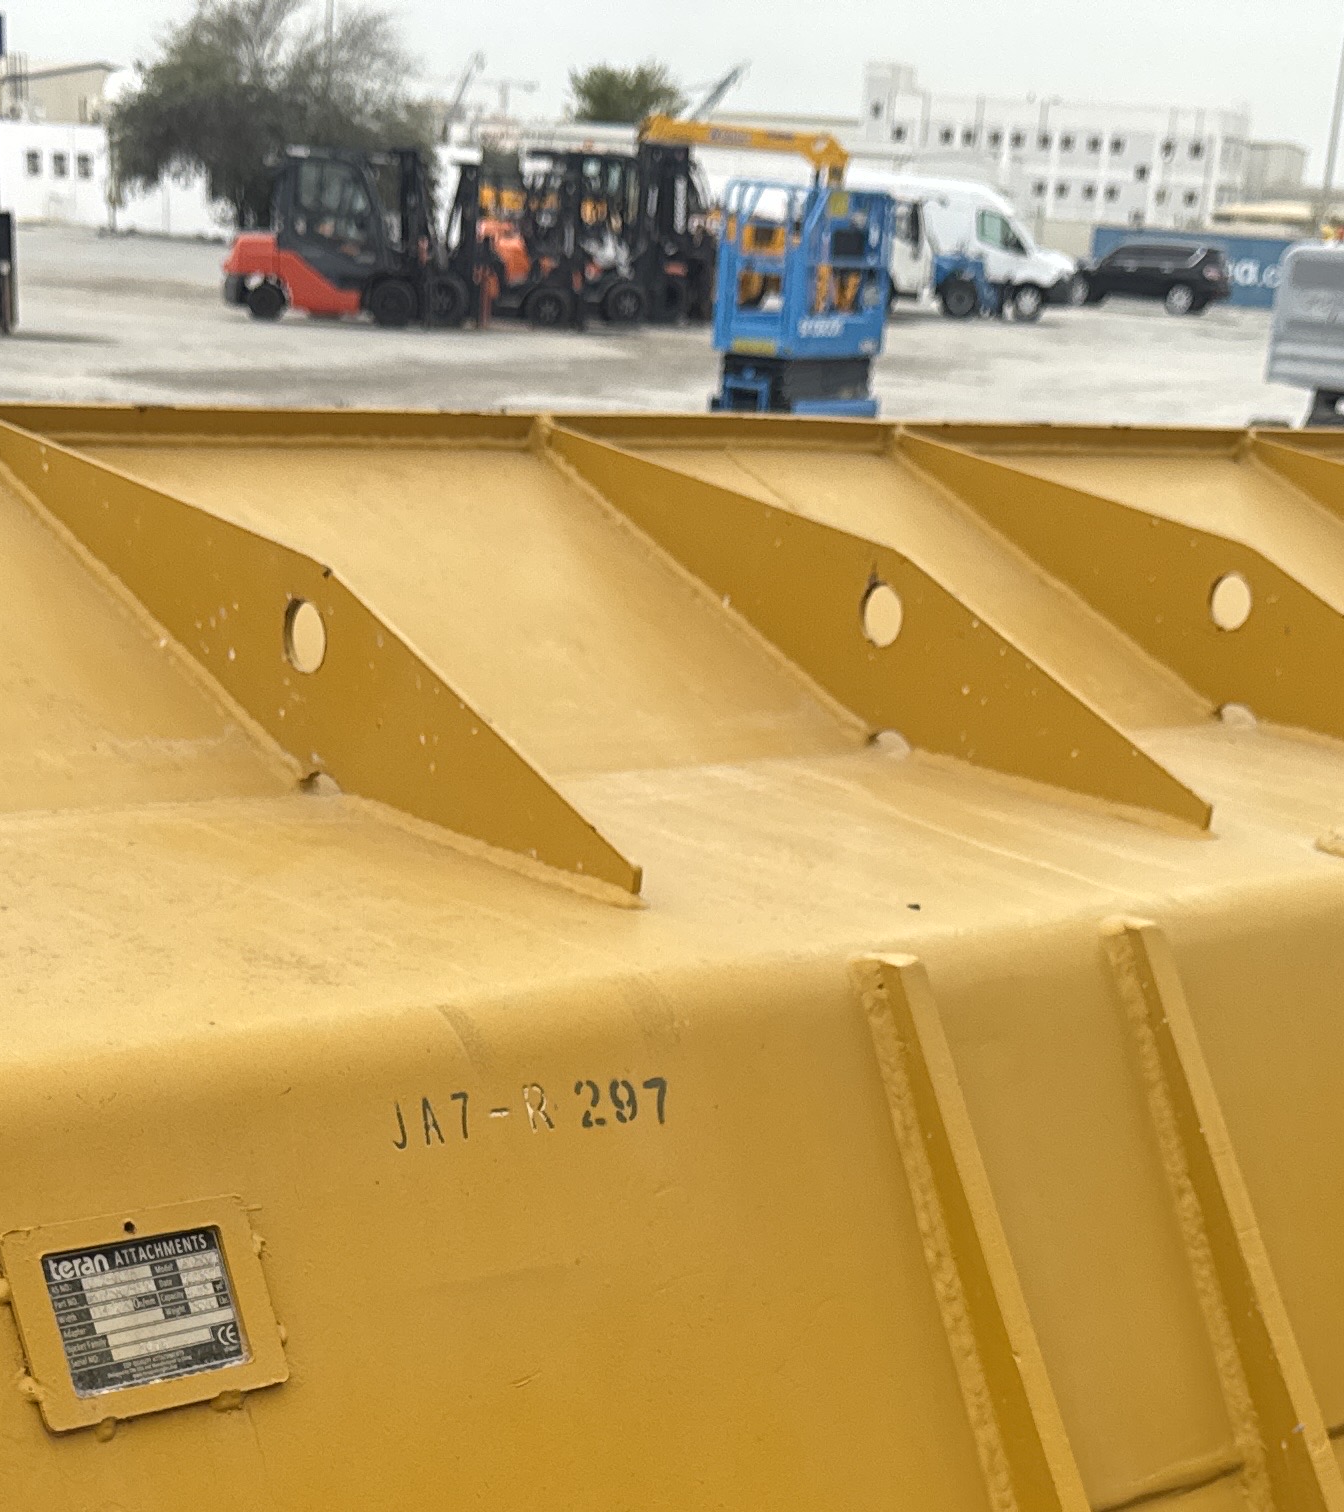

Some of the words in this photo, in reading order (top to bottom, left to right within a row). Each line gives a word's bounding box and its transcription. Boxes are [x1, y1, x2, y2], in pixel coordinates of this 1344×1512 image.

[574, 1076, 668, 1129] 297
[48, 1254, 110, 1281] teran
[114, 1234, 207, 1267] ATTACHMENTS
